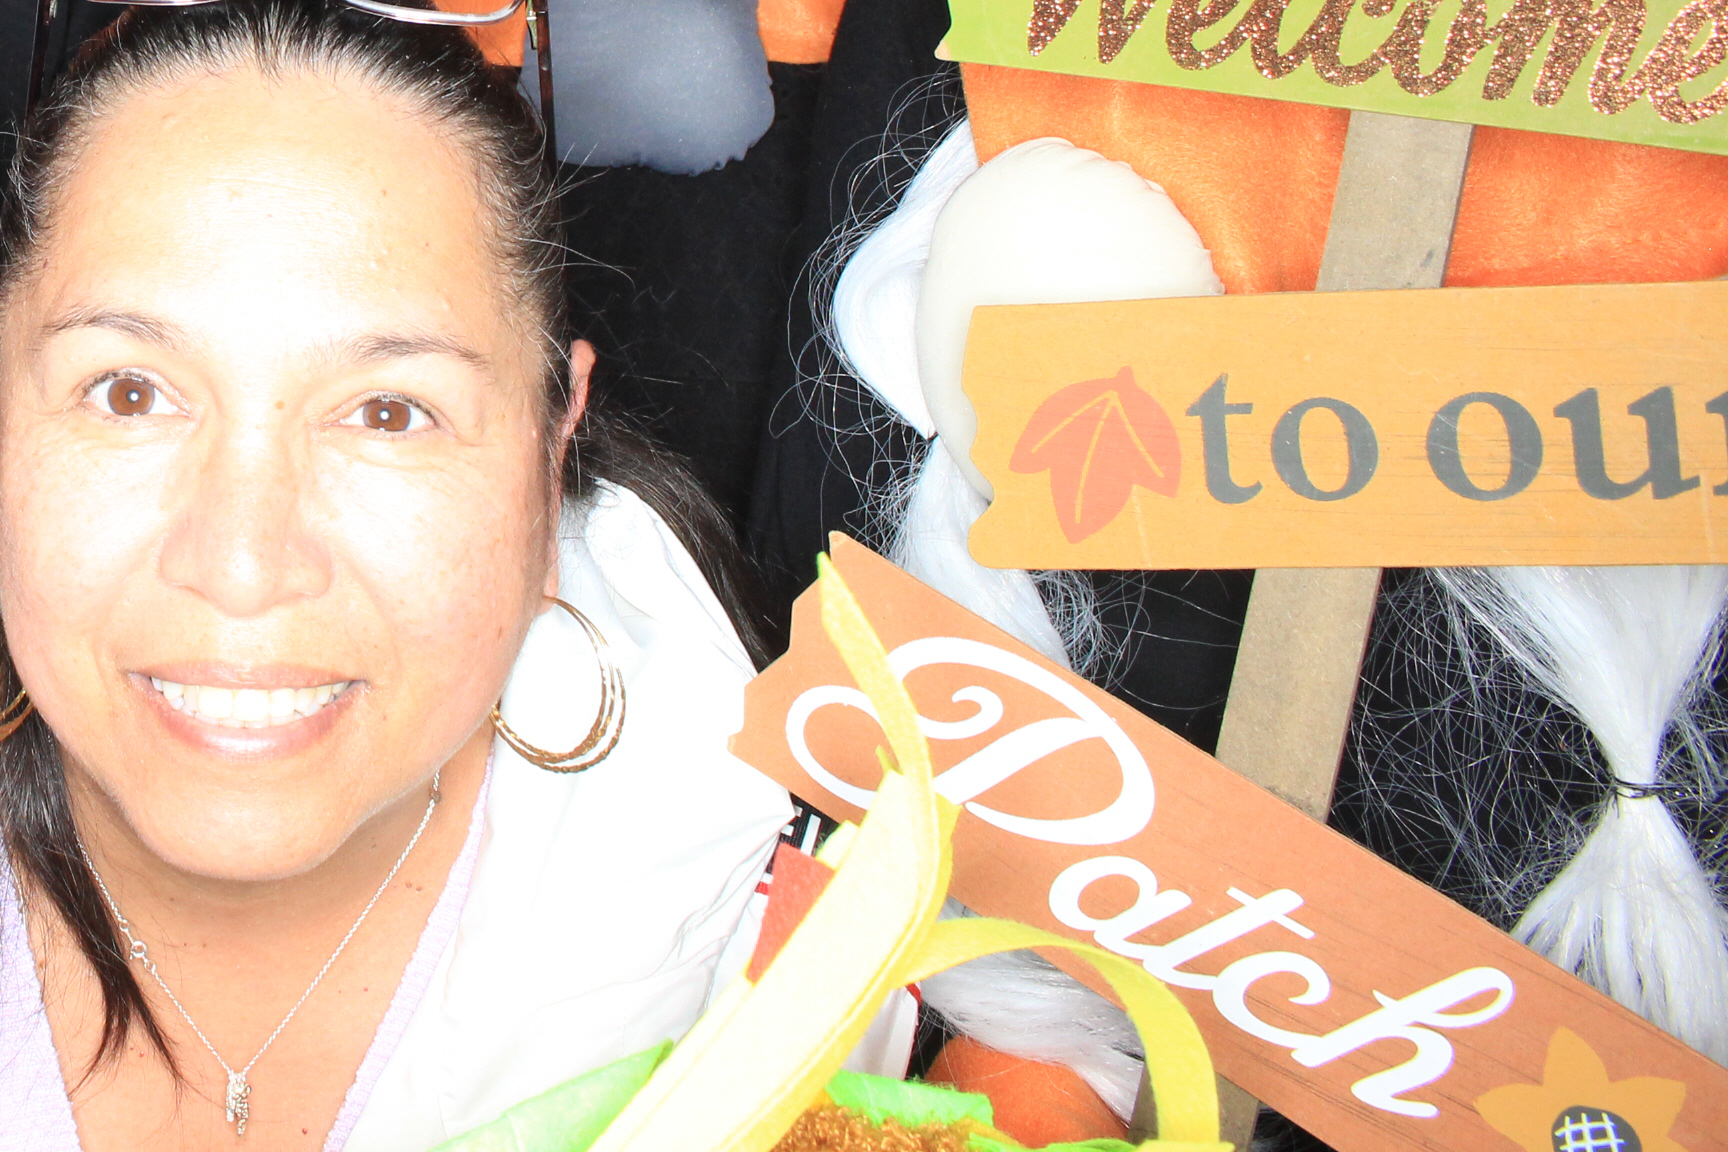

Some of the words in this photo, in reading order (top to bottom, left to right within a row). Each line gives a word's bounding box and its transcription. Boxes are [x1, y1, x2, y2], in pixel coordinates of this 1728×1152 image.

[1185, 372, 1380, 504] to
[1425, 387, 1728, 502] ou
[784, 636, 1517, 1119] Patch
